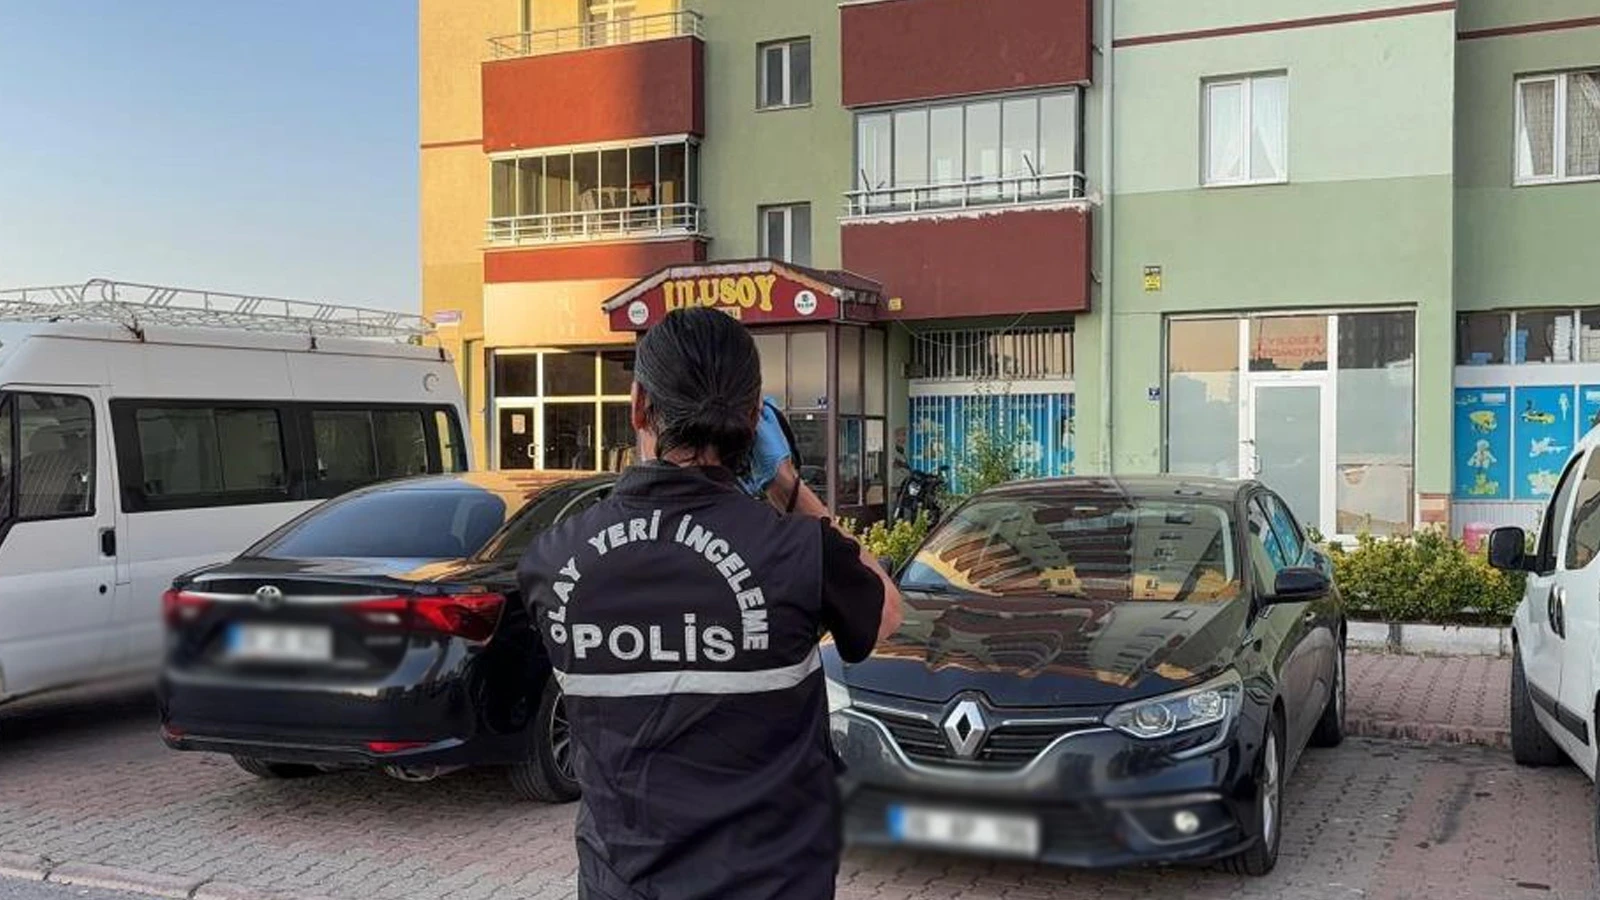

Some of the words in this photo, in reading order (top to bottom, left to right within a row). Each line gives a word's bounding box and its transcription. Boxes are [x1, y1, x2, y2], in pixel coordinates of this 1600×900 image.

[663, 274, 776, 311] ULUSOY
[549, 557, 582, 644] OLAY
[588, 509, 661, 556] YERİ
[674, 513, 770, 651] İNCELEME
[572, 613, 736, 662] POLİS
